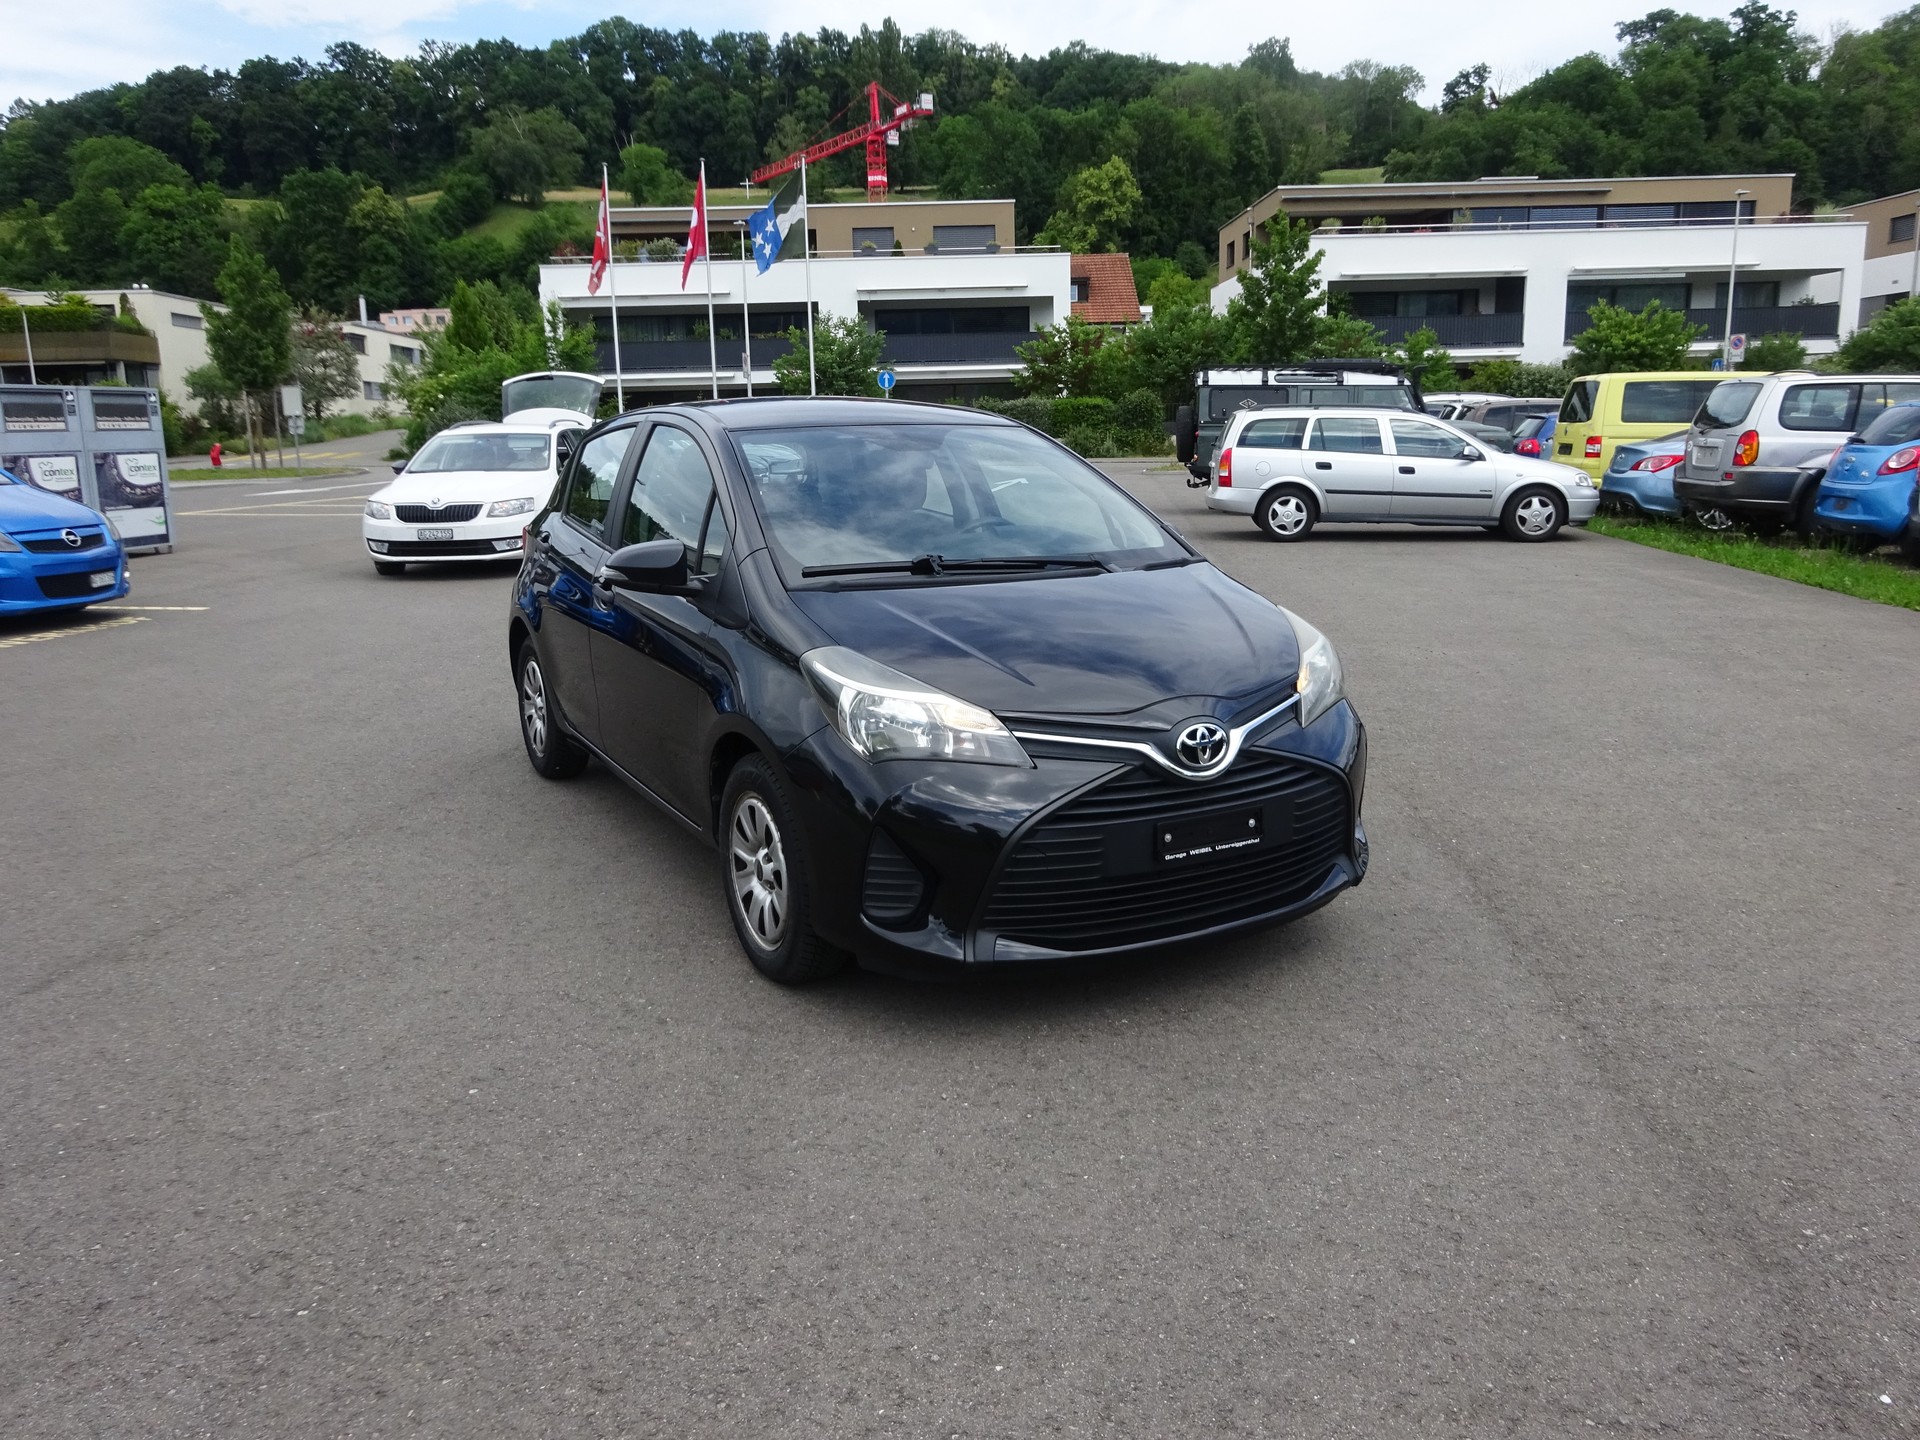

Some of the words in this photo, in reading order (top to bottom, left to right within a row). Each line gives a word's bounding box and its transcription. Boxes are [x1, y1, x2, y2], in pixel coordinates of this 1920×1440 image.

[44, 467, 75, 477] contex
[130, 463, 157, 472] contex
[1165, 852, 1187, 860] Garage
[1189, 847, 1212, 855] WEIBEL
